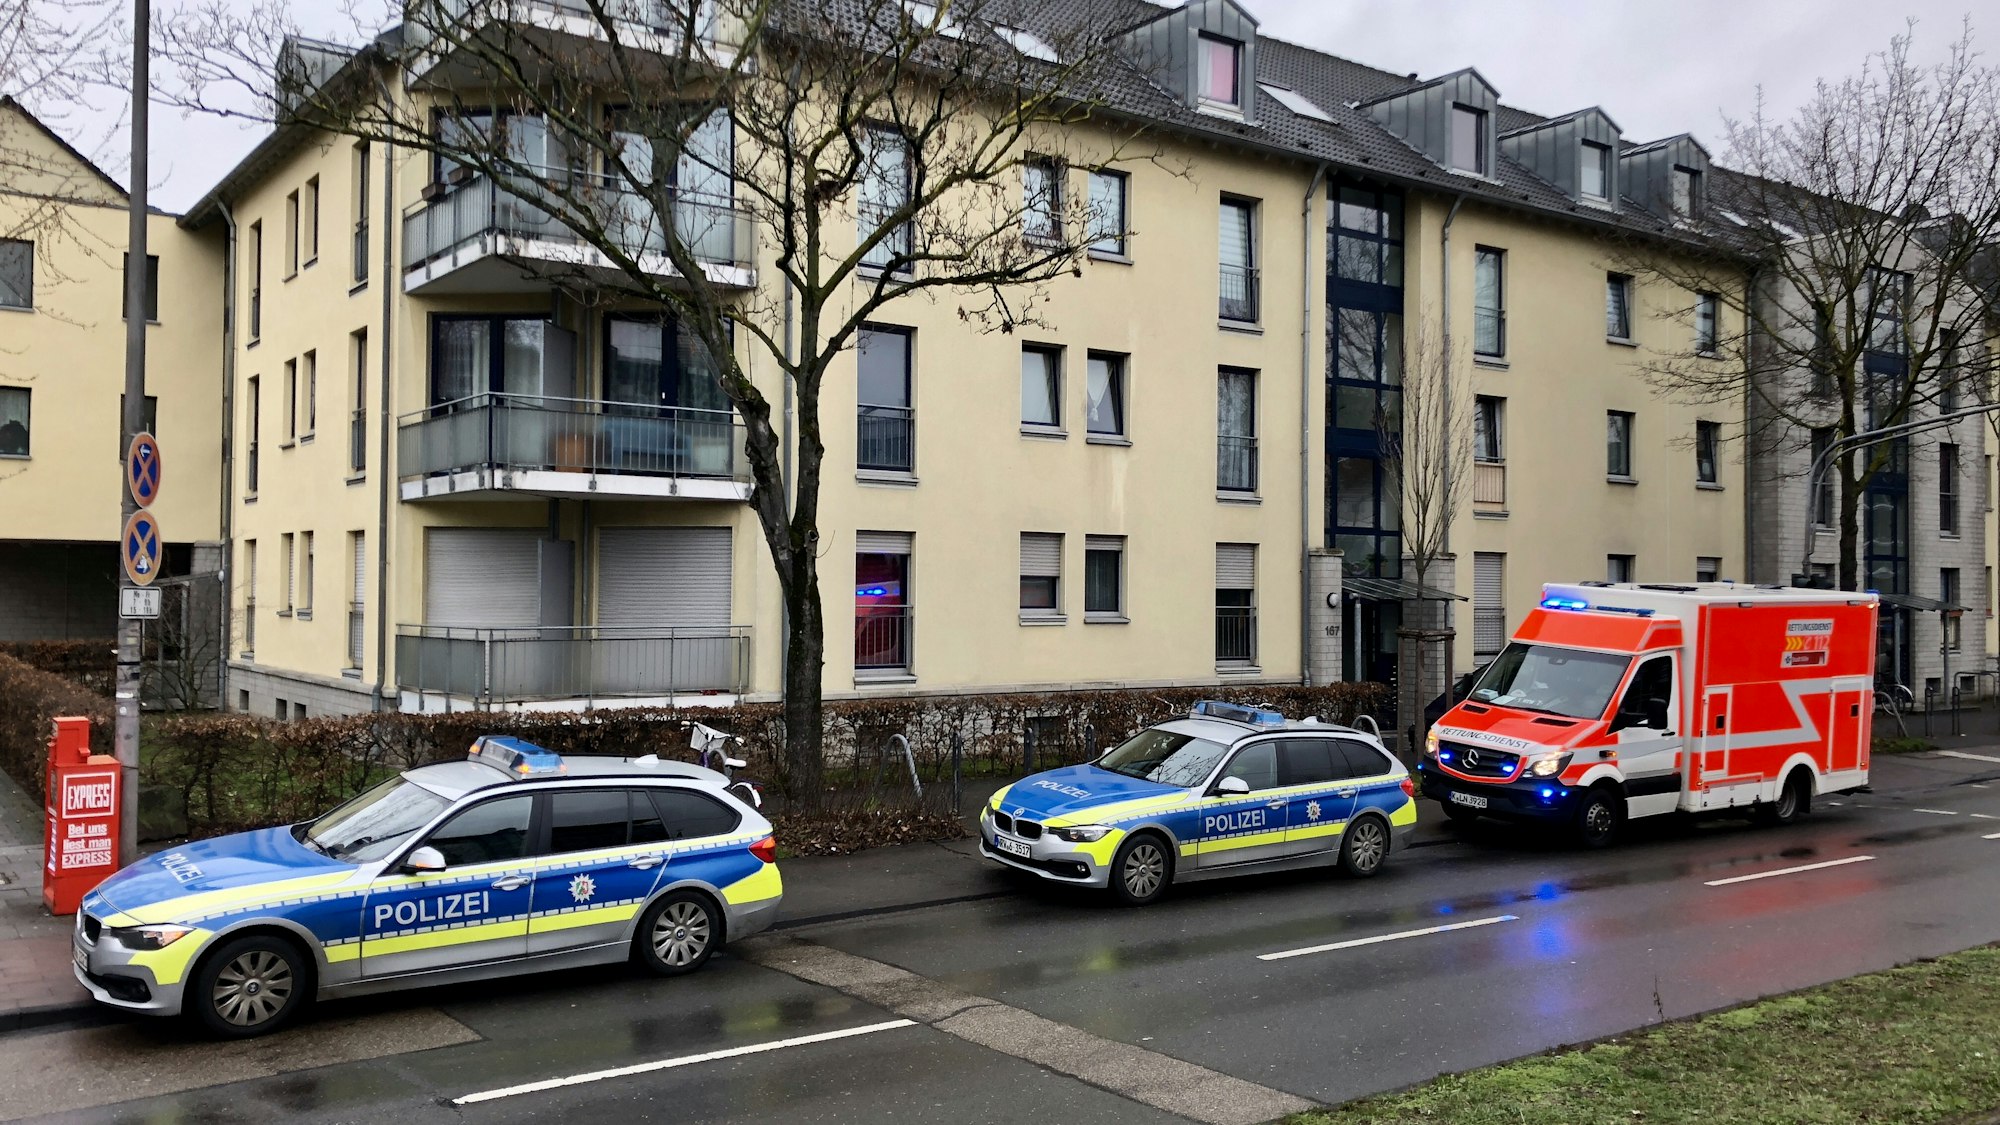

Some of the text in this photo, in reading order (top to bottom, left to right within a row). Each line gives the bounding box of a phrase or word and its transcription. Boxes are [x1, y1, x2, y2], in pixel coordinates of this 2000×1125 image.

[1325, 626, 1340, 636] 167
[1787, 622, 1832, 632] RETTUNGSDIENST
[1814, 635, 1831, 650] 112
[1440, 727, 1530, 749] RETTUNGSDIENST
[67, 783, 110, 810] EXPRESS
[1032, 780, 1093, 799] POLIZEI
[88, 824, 107, 835] uns
[1205, 809, 1266, 833] POLIZEI
[63, 838, 111, 851] liest man
[62, 850, 111, 867] EXPRESS
[156, 853, 205, 883] POLIZEI
[374, 891, 489, 928] POLIZEI
